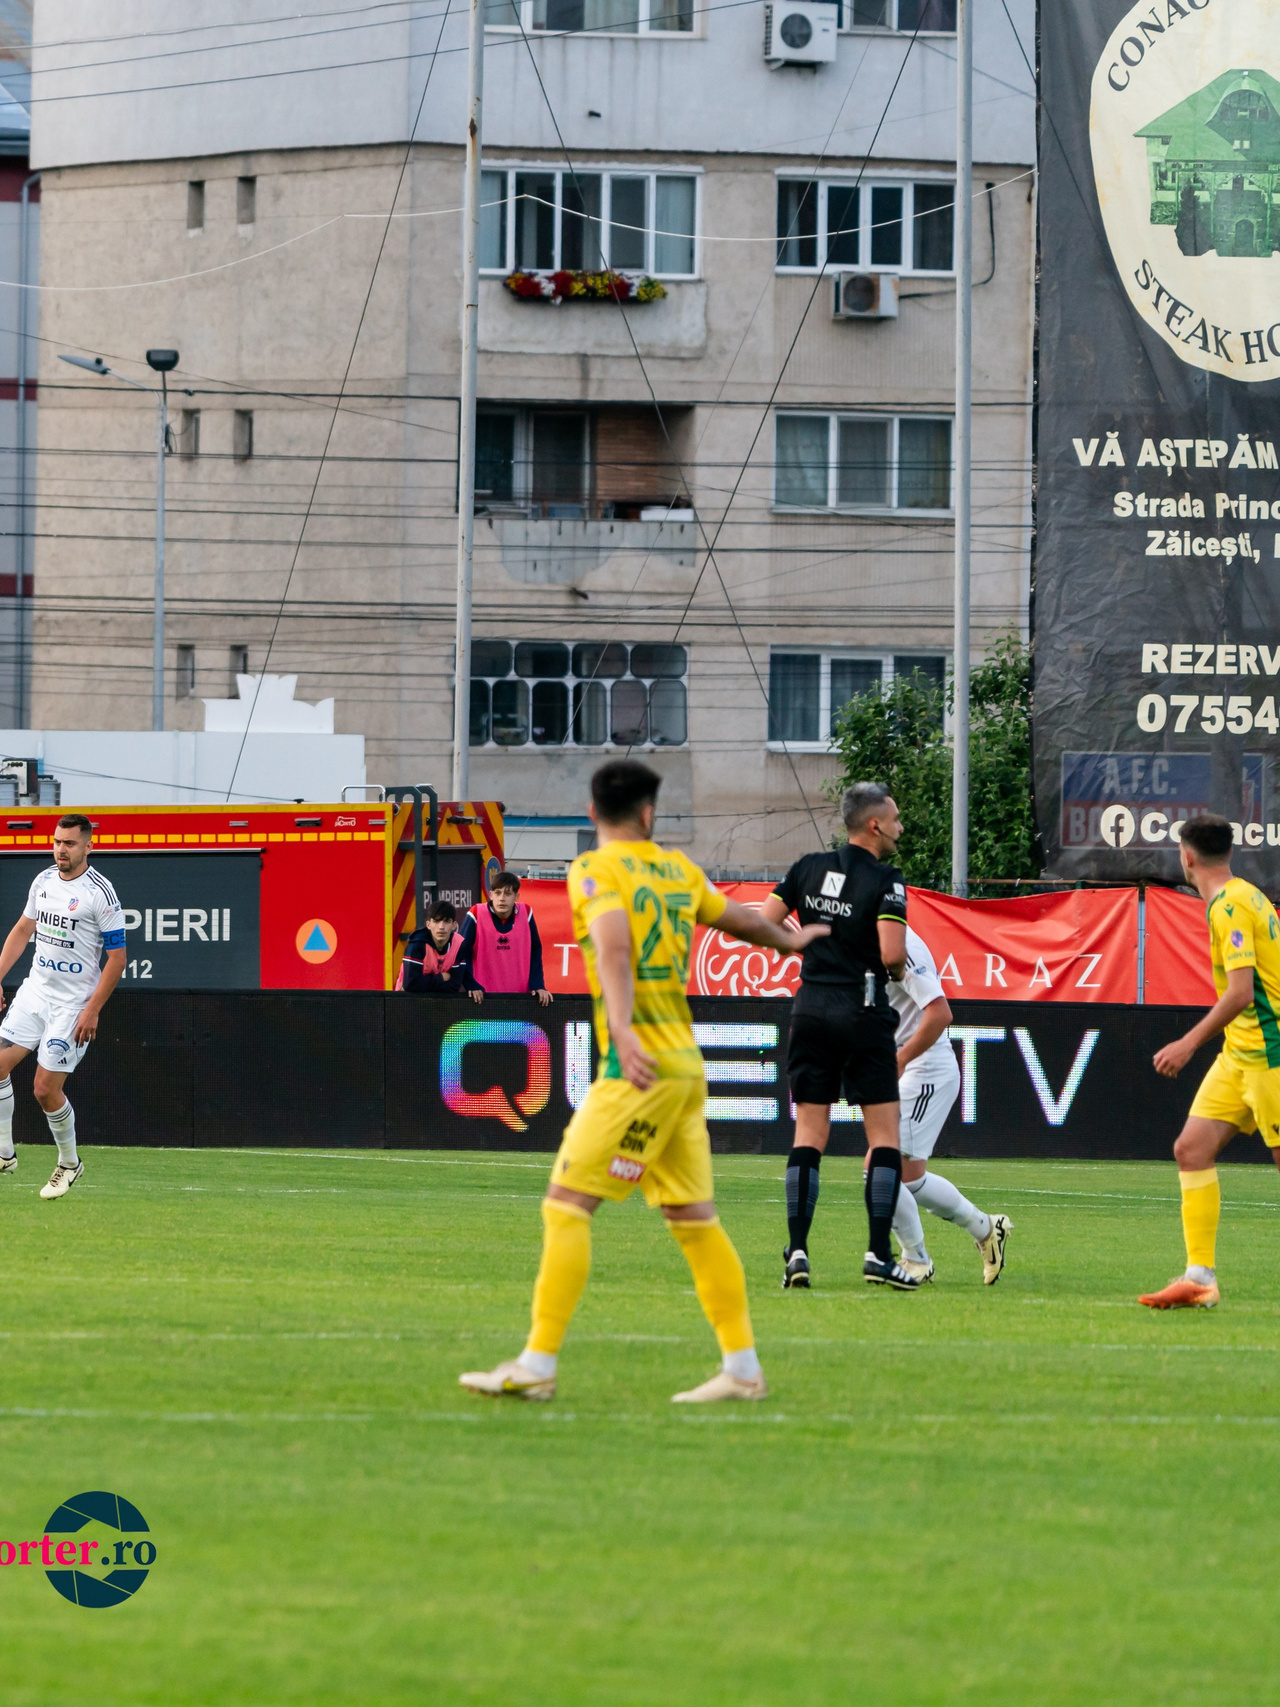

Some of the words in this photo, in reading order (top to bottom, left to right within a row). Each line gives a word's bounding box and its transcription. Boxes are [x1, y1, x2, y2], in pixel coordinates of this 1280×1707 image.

[1134, 259, 1233, 363] STEAK
[1072, 431, 1126, 467] VĂ
[1137, 433, 1280, 477] AȘTEPĂM
[1113, 491, 1206, 518] Strada
[1145, 530, 1261, 565] Zăicești,
[1137, 693, 1280, 735] 07554
[423, 889, 473, 909] PMPIERII
[804, 894, 853, 918] NORDIS
[122, 908, 231, 942] PIERII
[633, 885, 694, 985] 25
[37, 956, 83, 974] SACO
